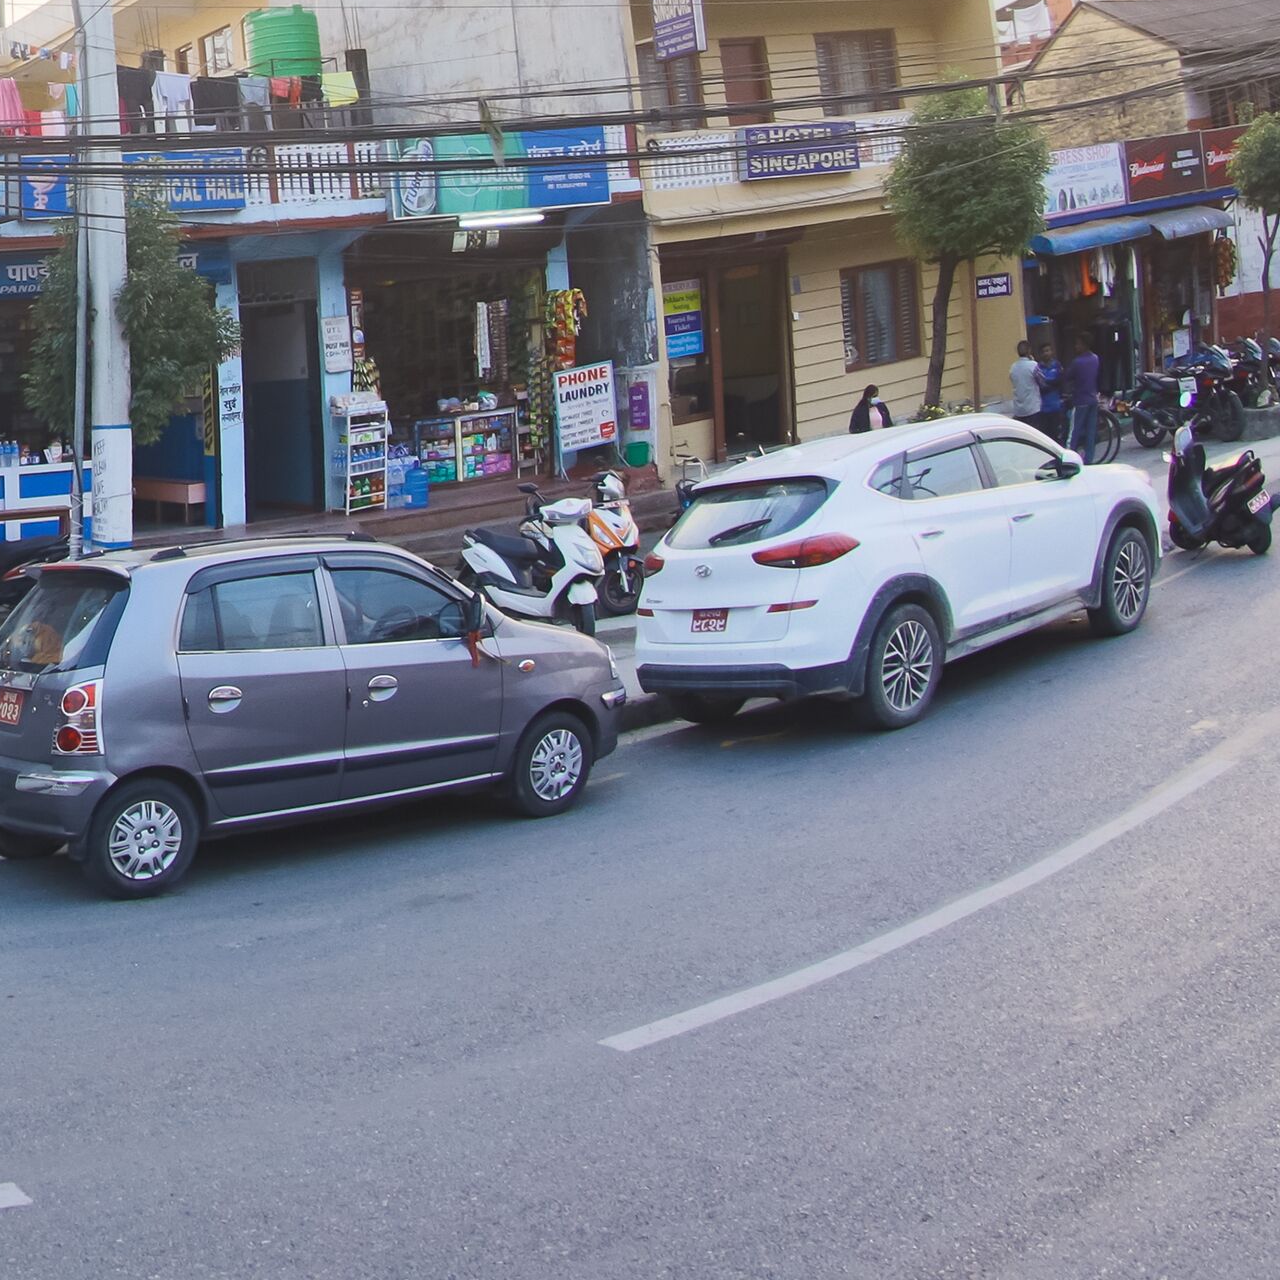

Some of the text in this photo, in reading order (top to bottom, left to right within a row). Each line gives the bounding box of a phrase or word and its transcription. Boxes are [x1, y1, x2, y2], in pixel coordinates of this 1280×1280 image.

[769, 127, 832, 143] HOTEL
[749, 148, 857, 173] SINGAPORE
[1086, 145, 1111, 161] SHOP
[1129, 162, 1165, 177] Budweiser
[206, 176, 244, 200] HALL
[674, 322, 691, 333] Ticket
[558, 366, 608, 388] PHONE
[559, 382, 610, 403] LAUNDRY
